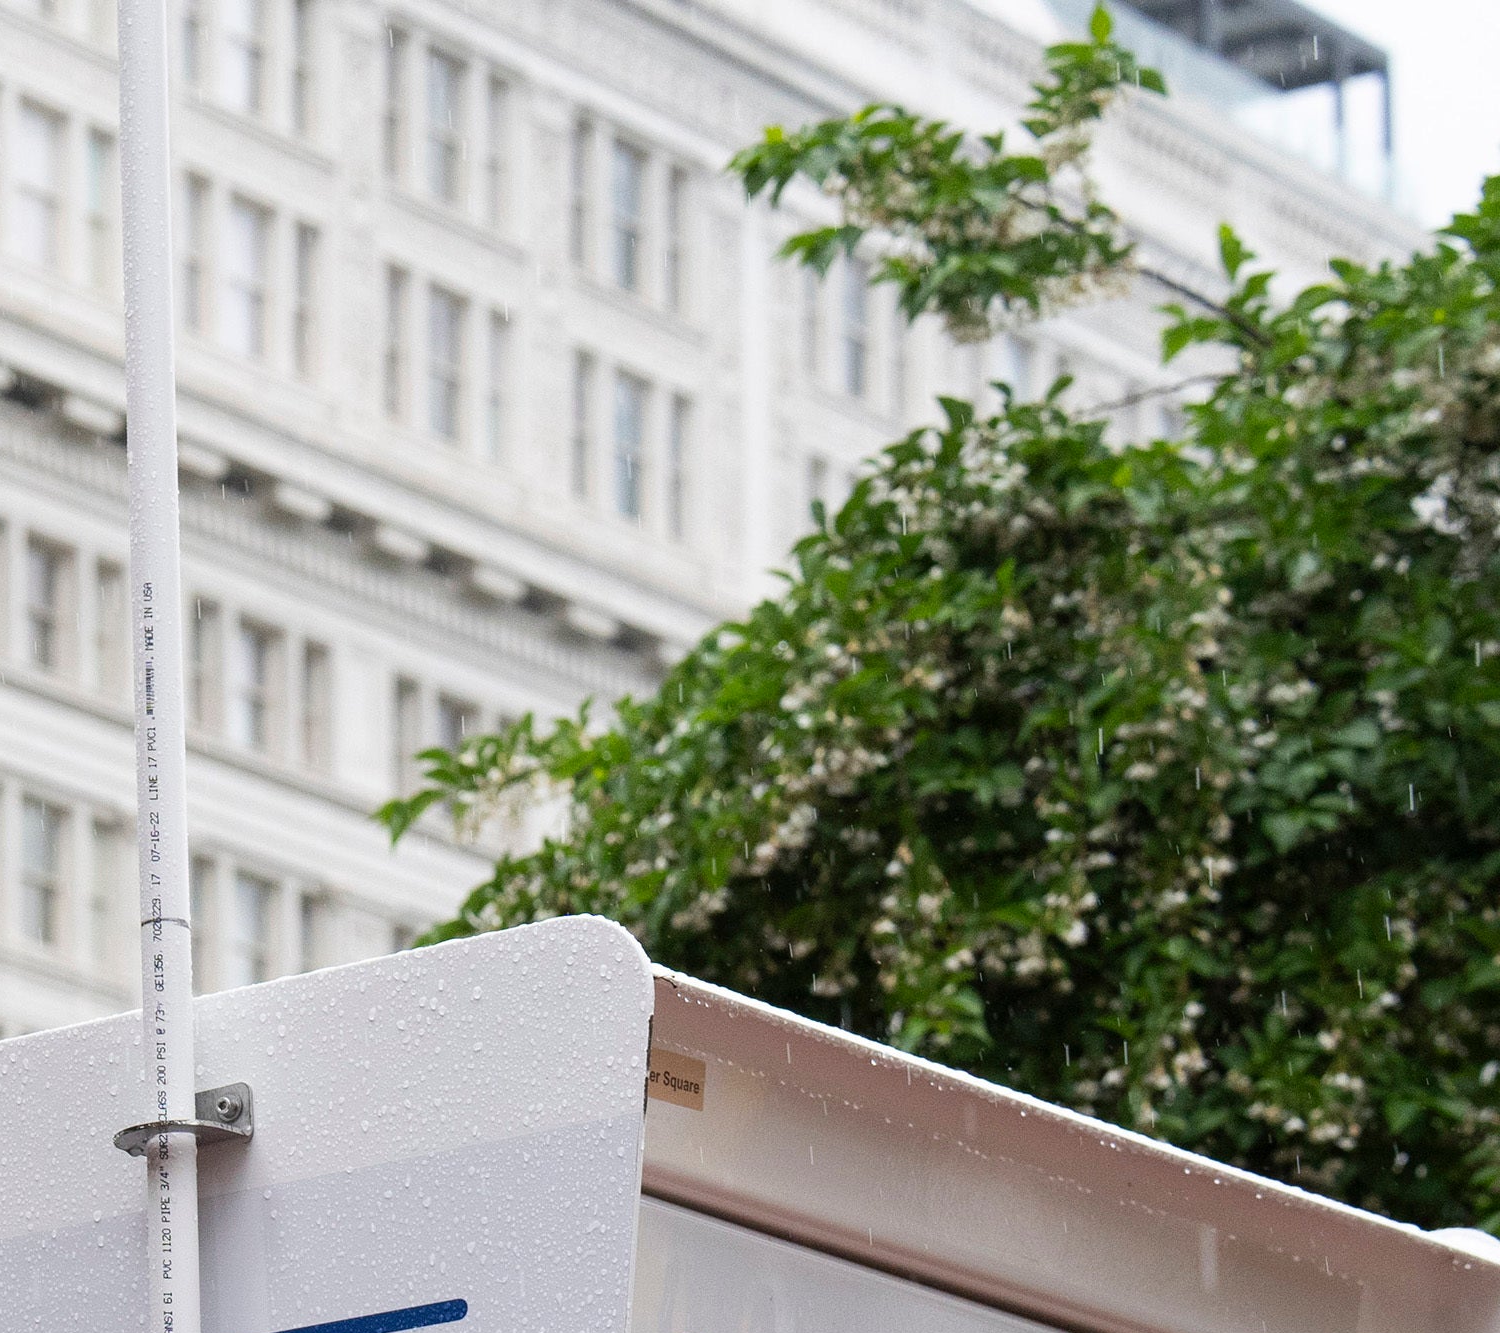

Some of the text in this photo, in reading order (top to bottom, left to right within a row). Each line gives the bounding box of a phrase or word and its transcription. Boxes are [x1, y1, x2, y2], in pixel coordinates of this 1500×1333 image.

[142, 582, 153, 601] USA
[143, 607, 153, 619] IN
[143, 625, 155, 651] MADE
[146, 726, 157, 752] PVC1
[147, 757, 158, 769] 17
[147, 774, 158, 801] LINE
[148, 811, 161, 863] 07-16-22
[151, 874, 161, 886] 17
[155, 1042, 166, 1061] PSI
[155, 1065, 166, 1086] 200
[663, 1070, 700, 1094] Square
[157, 1090, 168, 1121] CLASS
[159, 1134, 169, 1160] SDR2
[160, 1197, 171, 1223] PIPE
[161, 1228, 172, 1253] 1120
[162, 1258, 173, 1280] PVC
[163, 1292, 173, 1304] 61
